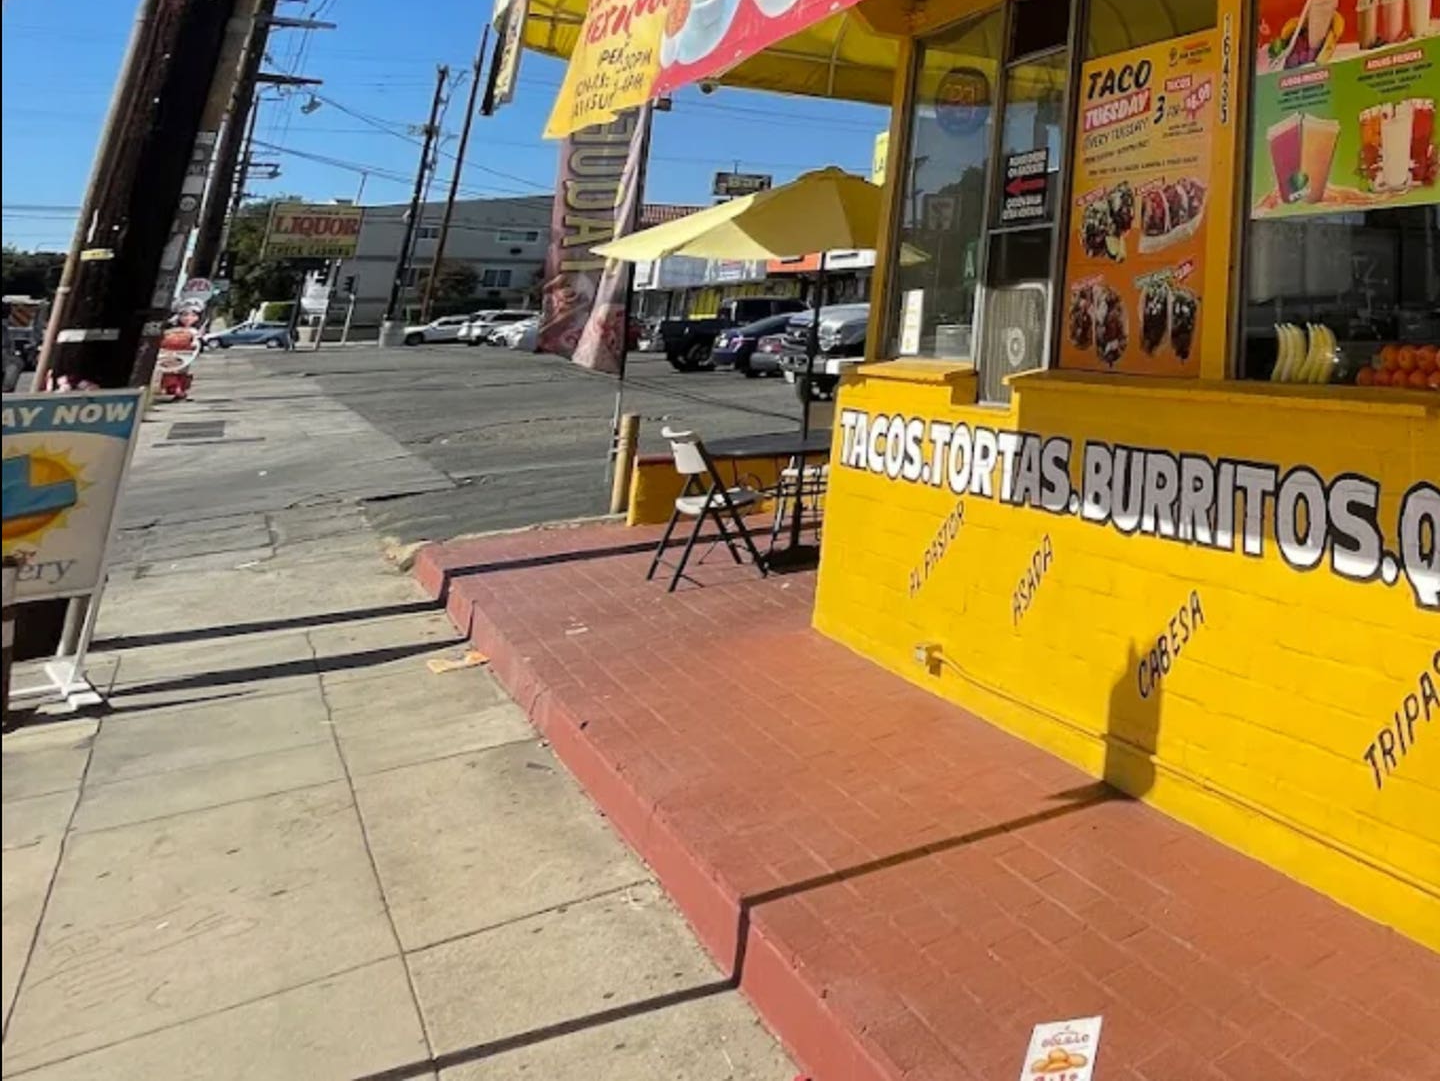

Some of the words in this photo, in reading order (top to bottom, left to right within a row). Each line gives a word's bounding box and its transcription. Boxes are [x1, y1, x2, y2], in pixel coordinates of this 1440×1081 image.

[1087, 59, 1153, 101] TACO
[1084, 88, 1150, 130] TUESDAY
[1153, 94, 1166, 125] 3
[273, 216, 361, 237] LIQUOR
[964, 250, 975, 278] A
[51, 401, 134, 426] NOW
[1012, 533, 1054, 627] ASADA
[1136, 589, 1206, 700] CABESA
